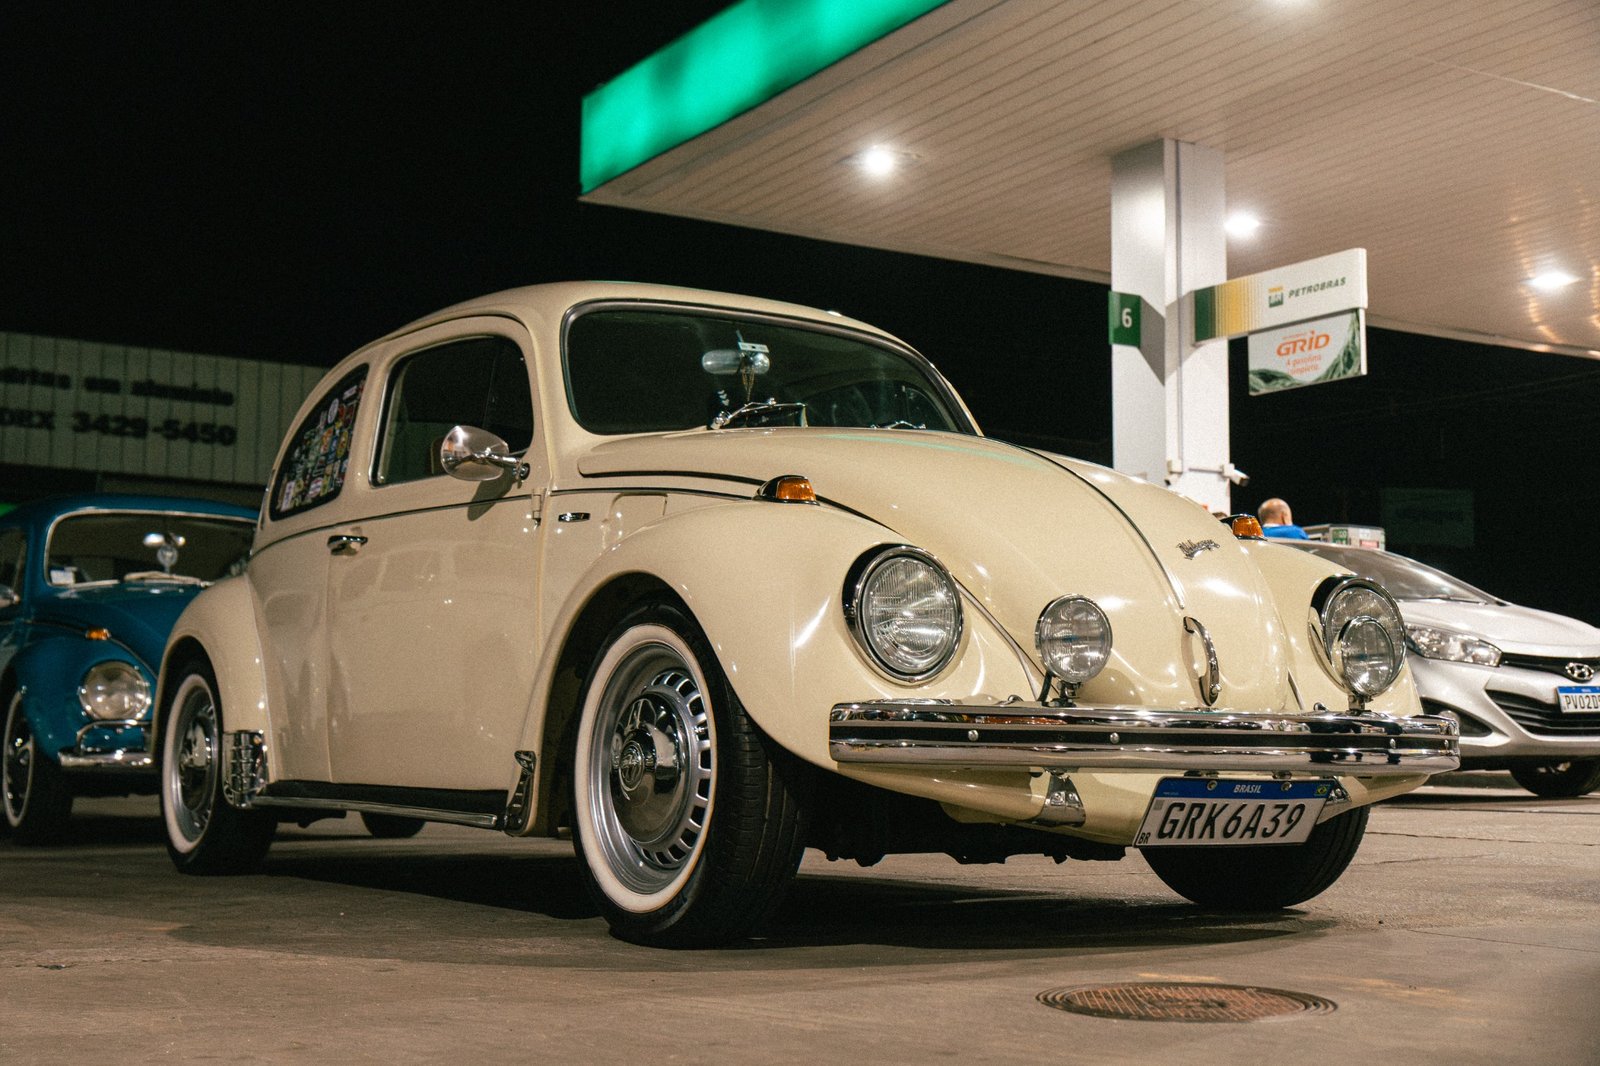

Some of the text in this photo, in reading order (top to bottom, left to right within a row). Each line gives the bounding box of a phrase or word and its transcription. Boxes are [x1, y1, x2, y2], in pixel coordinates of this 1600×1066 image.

[1288, 276, 1346, 298] PETROBRAS
[1121, 308, 1132, 328] 6
[1233, 784, 1261, 794] BRASIL
[1157, 802, 1306, 839] GRK6A39
[1138, 832, 1151, 844] BR
